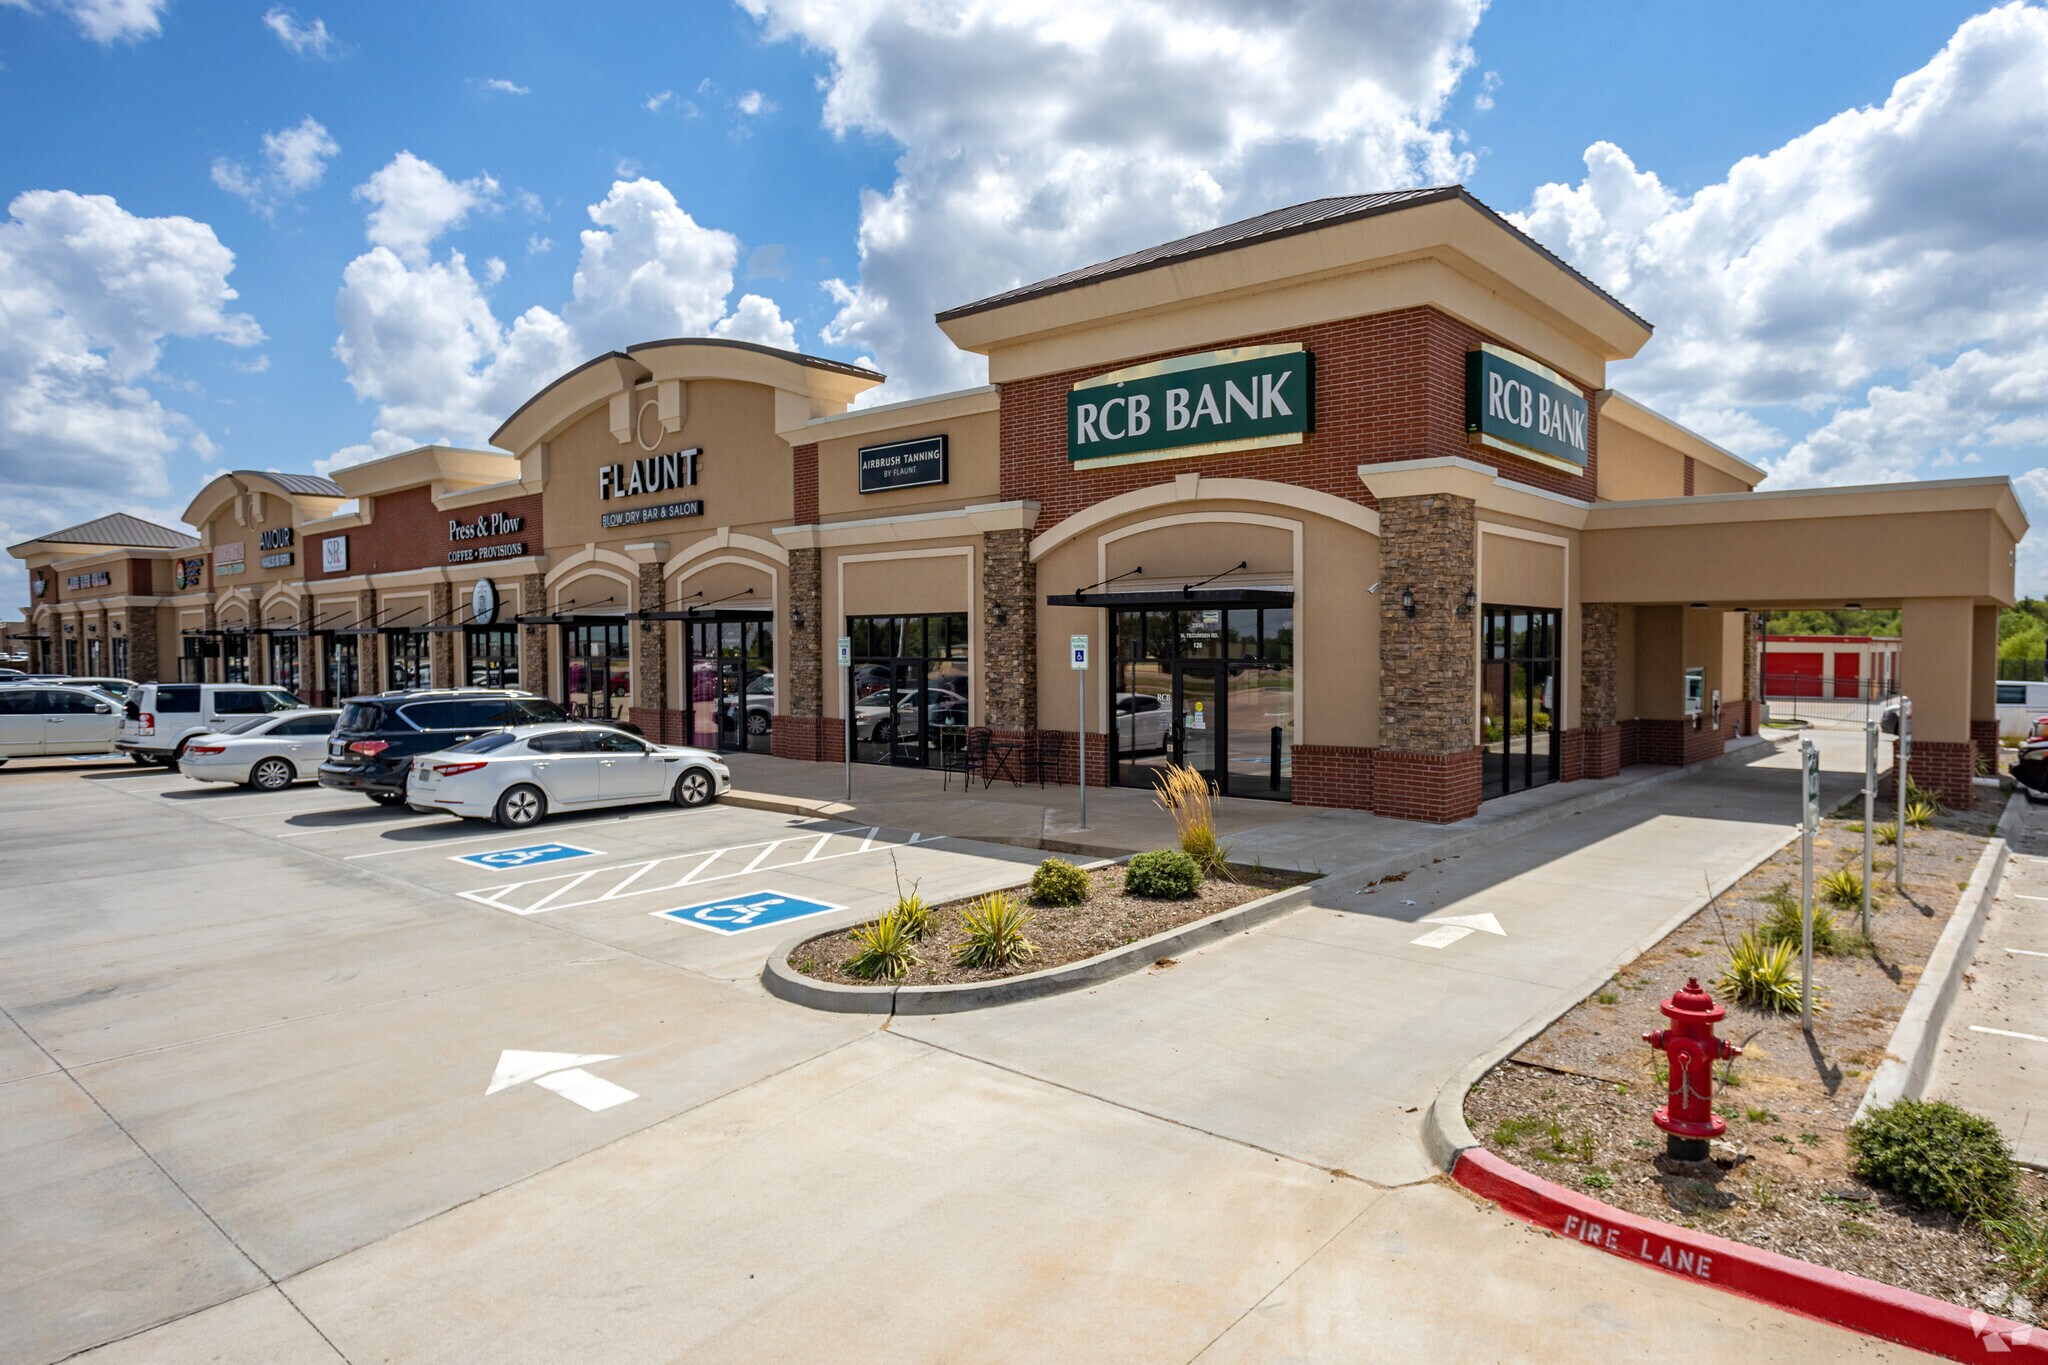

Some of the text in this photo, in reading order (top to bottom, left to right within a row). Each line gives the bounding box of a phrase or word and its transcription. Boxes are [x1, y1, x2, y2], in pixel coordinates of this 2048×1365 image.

[1077, 370, 1293, 444] RCB BANK
[1489, 371, 1585, 451] RCB BANK
[862, 449, 940, 470] AIRBRUSH TANNING
[883, 465, 917, 478] BY FLAUNT
[599, 448, 699, 500] FLAUNT
[449, 512, 520, 541] Press & Plow
[602, 502, 698, 527] BLOW DRY BAR & SALON
[260, 528, 291, 550] AMOUR
[448, 543, 522, 563] COFFEE PROVISIONS
[1157, 693, 1171, 701] RCB
[1563, 1215, 1713, 1278] FIRE LANE
